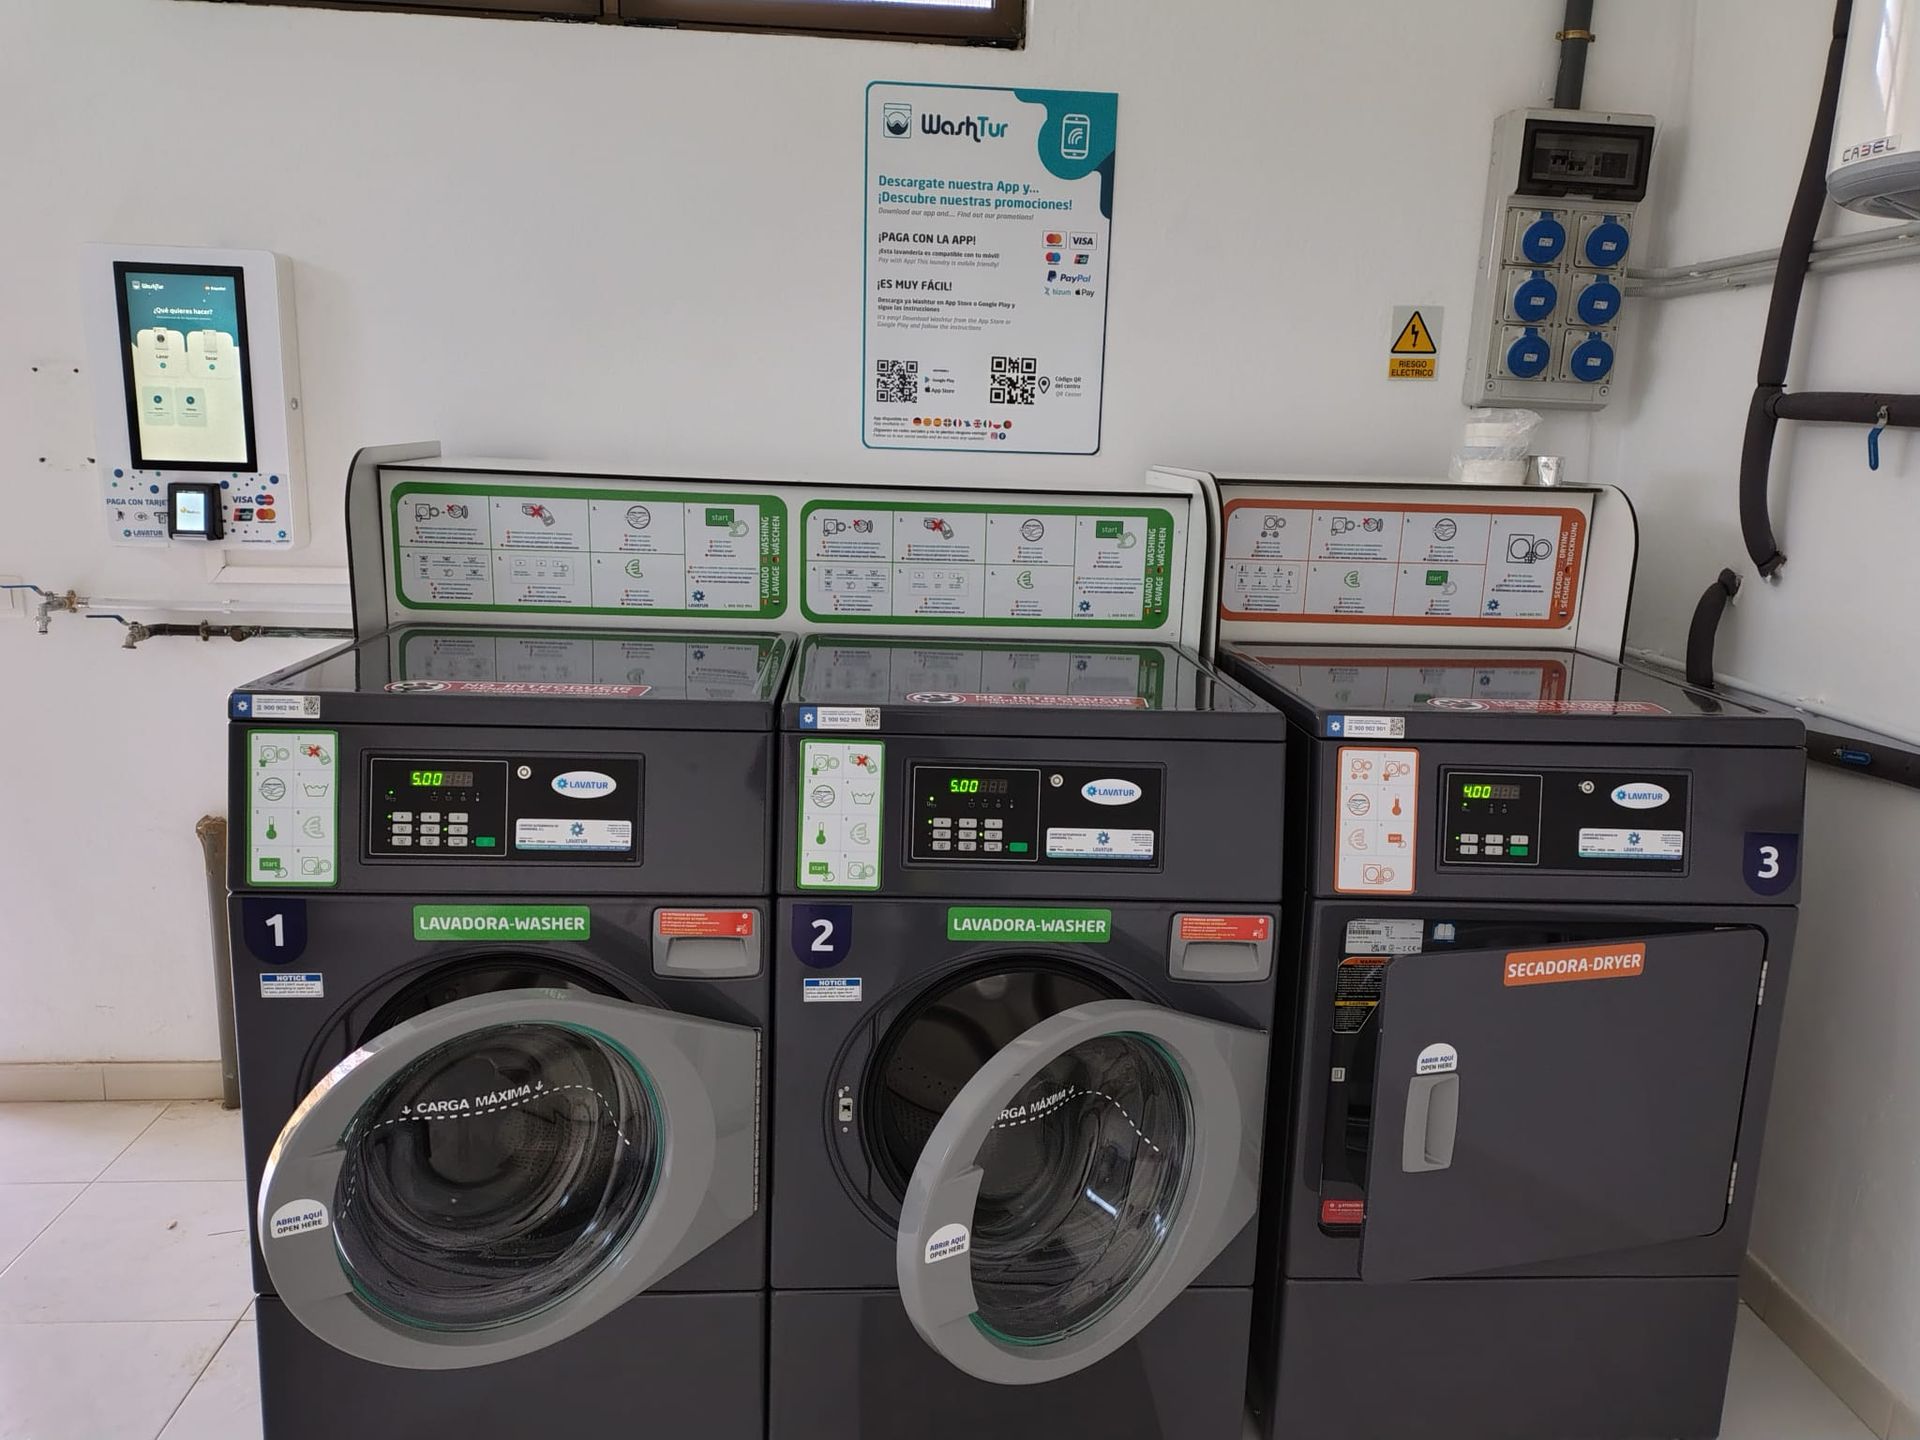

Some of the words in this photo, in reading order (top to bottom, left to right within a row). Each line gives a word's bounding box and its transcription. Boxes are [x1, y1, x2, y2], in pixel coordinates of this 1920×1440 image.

[921, 113, 1008, 142] WashTur
[878, 175, 945, 190] Descargate
[948, 180, 993, 191] nuestra
[997, 180, 1019, 194] App
[1022, 183, 1040, 196] y...
[878, 191, 936, 204] ¡Descubre
[940, 196, 991, 207] nuestras
[994, 197, 1073, 210] promociones!
[878, 207, 910, 215] Download
[878, 232, 910, 243] ¡PAGA
[912, 233, 934, 244] CON
[936, 234, 949, 244] LA
[952, 235, 976, 245] APP!
[1072, 237, 1093, 245] VISA
[877, 279, 892, 291] ¡ES
[895, 280, 918, 290] MUY
[921, 278, 952, 291] FÁCIL!
[1060, 273, 1091, 283] PayPal
[1081, 288, 1095, 298] Pay
[153, 306, 168, 314] ¿Qué
[998, 301, 1011, 309] Play
[1399, 360, 1427, 368] RIESGO
[232, 496, 253, 504] VISA
[711, 513, 729, 521] start
[761, 516, 770, 555] WASHING
[1147, 528, 1156, 566] WASHING
[1566, 521, 1578, 566] TROCKNUNG
[1554, 570, 1564, 599] SECADO
[1559, 531, 1569, 559] DRYING
[761, 566, 770, 599] LAVADO
[772, 565, 780, 596] LAVAGE
[1144, 577, 1153, 608] LAVADO
[1154, 576, 1164, 606] LAVAGE
[569, 779, 608, 790] LAVATUR
[950, 780, 979, 794] 5.00
[1463, 785, 1492, 799] 4.00
[1099, 788, 1135, 797] LAVATUR
[1627, 792, 1663, 801] LAVATUR
[262, 860, 278, 868] start
[1757, 845, 1779, 879] 3
[265, 914, 284, 947] 1
[419, 916, 585, 931] LAVADORA-WASHER
[953, 918, 1106, 933] LAVADORA-WASHER
[810, 919, 834, 952] 2
[1507, 953, 1641, 978] SECADORA-DRYER
[1420, 1064, 1437, 1072] OPEN
[1438, 1062, 1453, 1070] HERE
[1421, 1056, 1439, 1064] ABRIR
[416, 1100, 470, 1113] CARGA
[475, 1084, 531, 1108] MÁXIMA
[996, 1105, 1027, 1121] RGA
[1030, 1088, 1067, 1113] MÁXIMA
[276, 1213, 301, 1226] ABRIR
[302, 1209, 323, 1221] AQUÍ
[277, 1225, 299, 1235] OPEN
[301, 1220, 323, 1230] HERE
[930, 1239, 950, 1251] ABRIR
[951, 1233, 966, 1245] AQUÍ
[930, 1250, 948, 1259] OPEN
[948, 1244, 965, 1253] HERE
